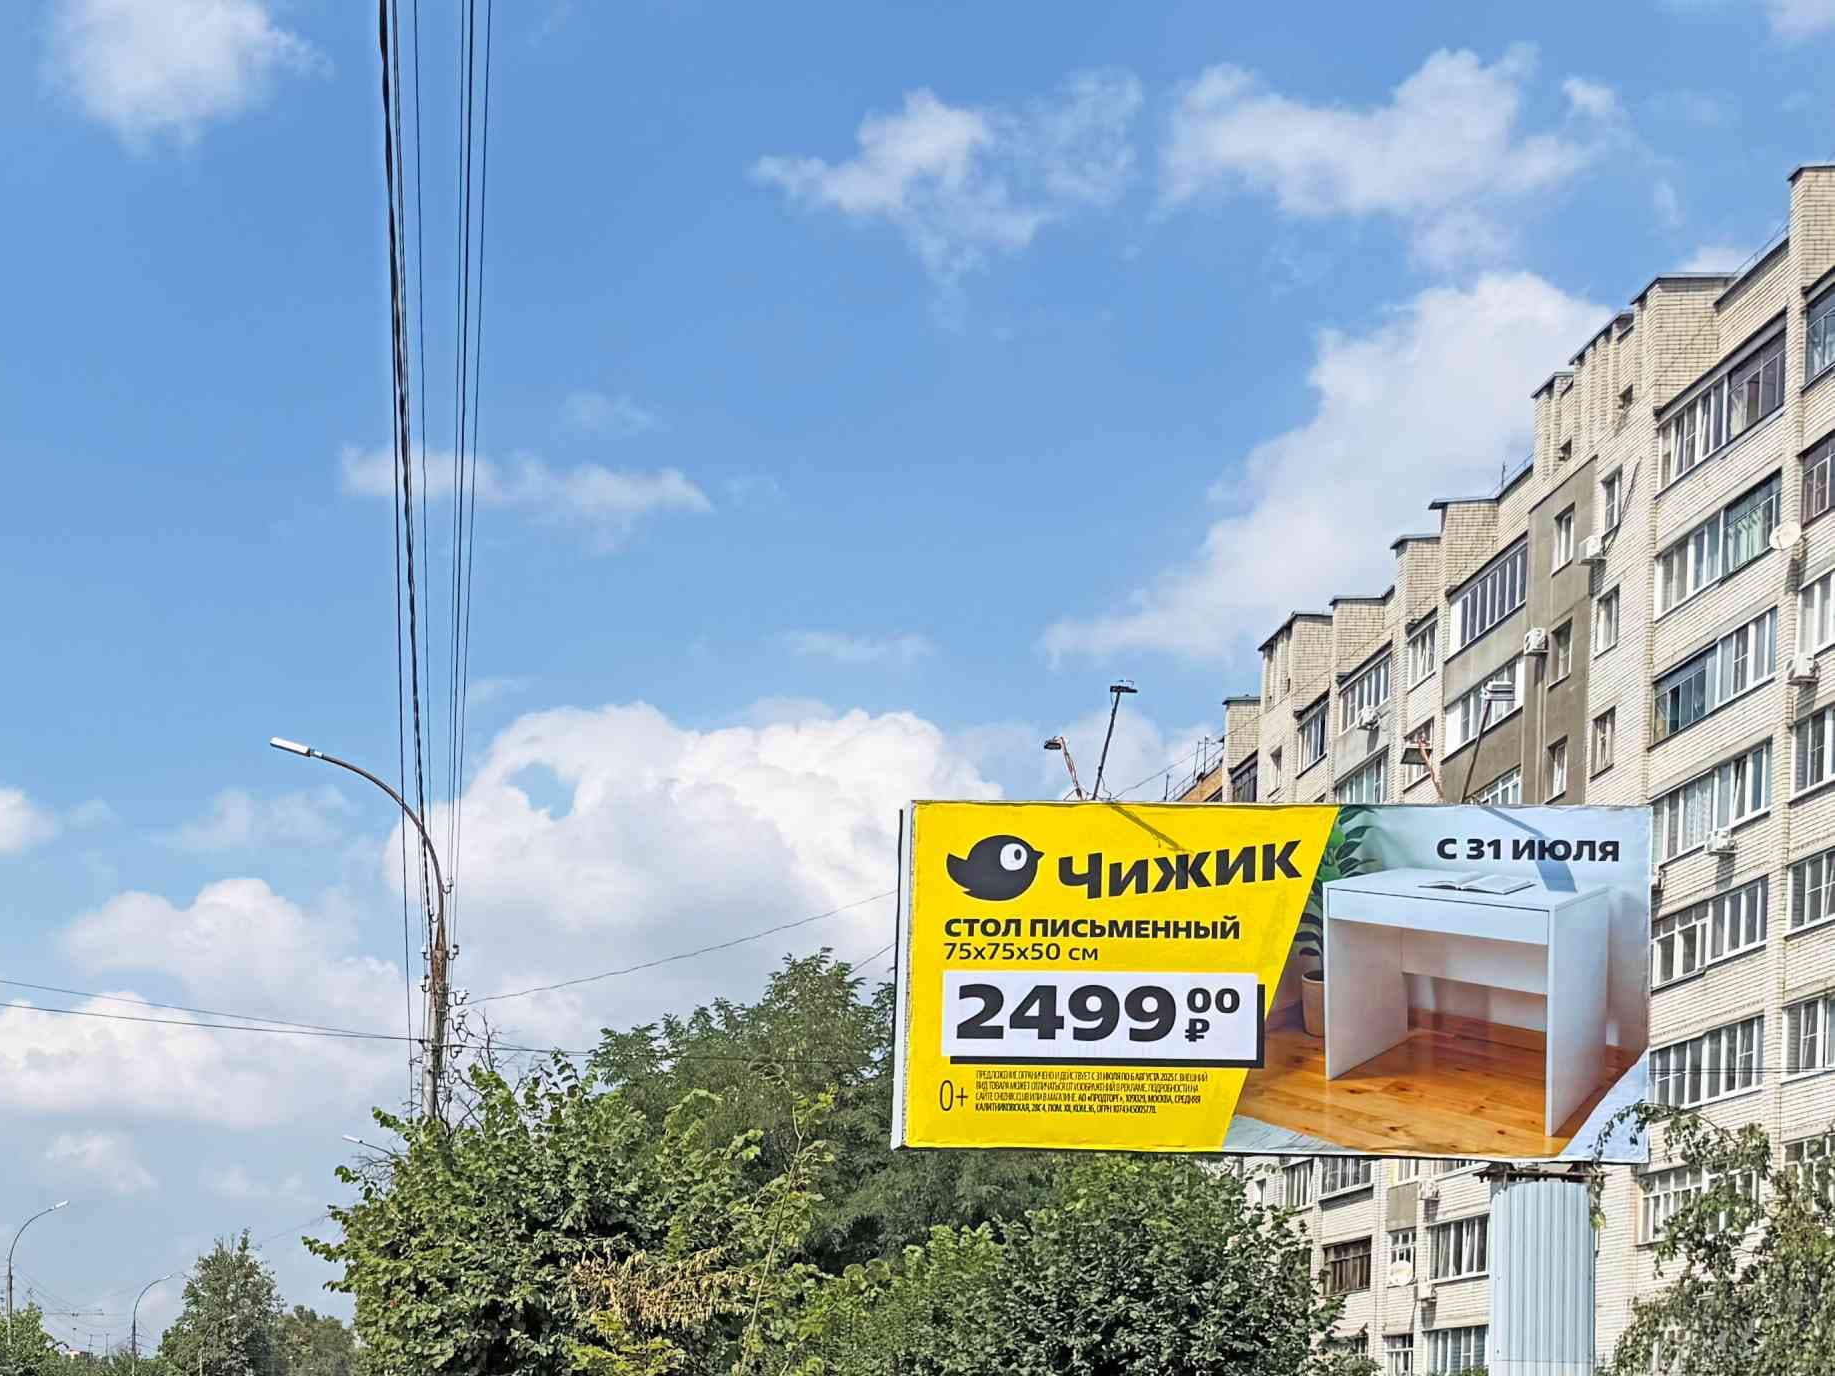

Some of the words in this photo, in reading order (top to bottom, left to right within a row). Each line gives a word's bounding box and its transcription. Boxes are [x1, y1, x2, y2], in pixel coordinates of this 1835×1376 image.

[1437, 838, 1457, 860] С
[1466, 838, 1502, 860] 31
[1512, 839, 1620, 862] ИЮЛЯ
[944, 918, 1022, 938] СТОЛ
[1029, 915, 1241, 940] ПИСЬМЕННЫЙ
[956, 983, 1177, 1042] 2499
[1186, 987, 1240, 1014] 00
[939, 1079, 969, 1112] 0+
